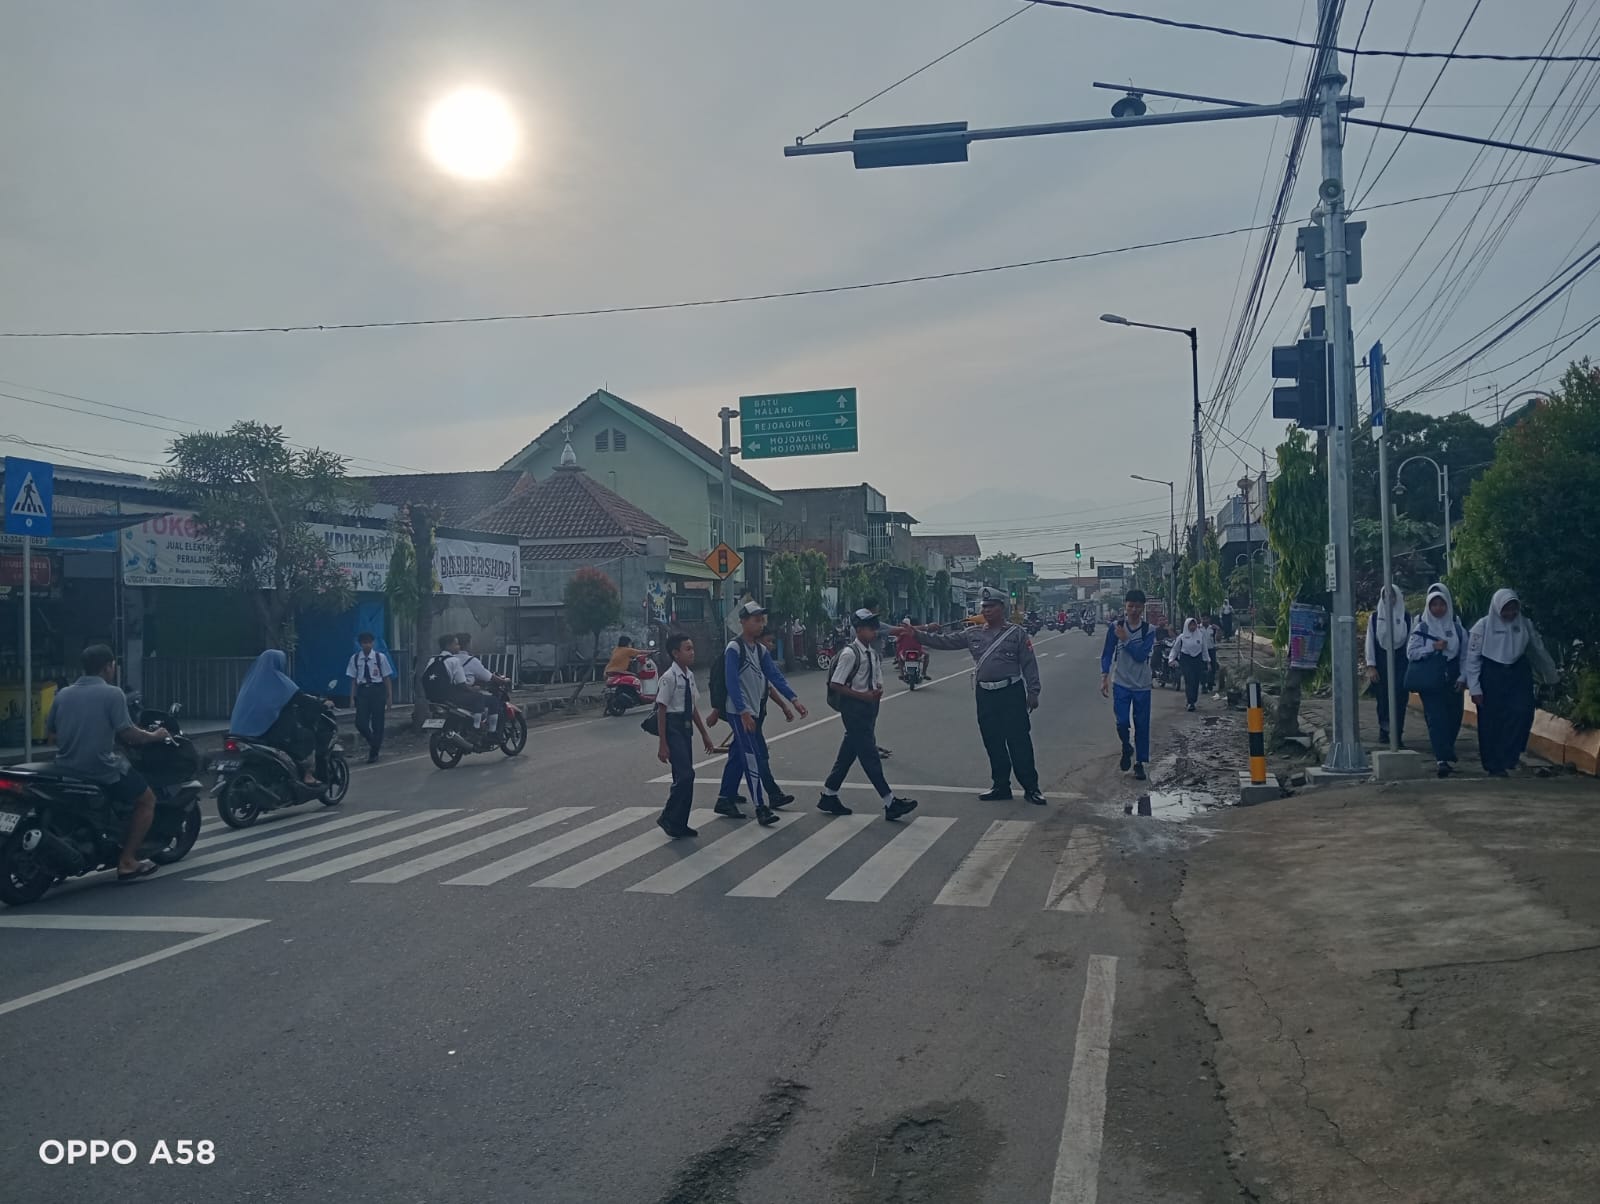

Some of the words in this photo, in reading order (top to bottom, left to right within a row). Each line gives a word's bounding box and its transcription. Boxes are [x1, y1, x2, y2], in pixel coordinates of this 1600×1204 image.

[754, 399, 778, 408] BATU
[754, 406, 794, 416] MALANG
[755, 420, 811, 431] REJOAGUNG
[770, 433, 829, 445] MOJOAGUNG
[770, 442, 831, 453] MOJOWARNO
[166, 541, 184, 550] JUAL
[440, 556, 511, 579] BARBERSHOP
